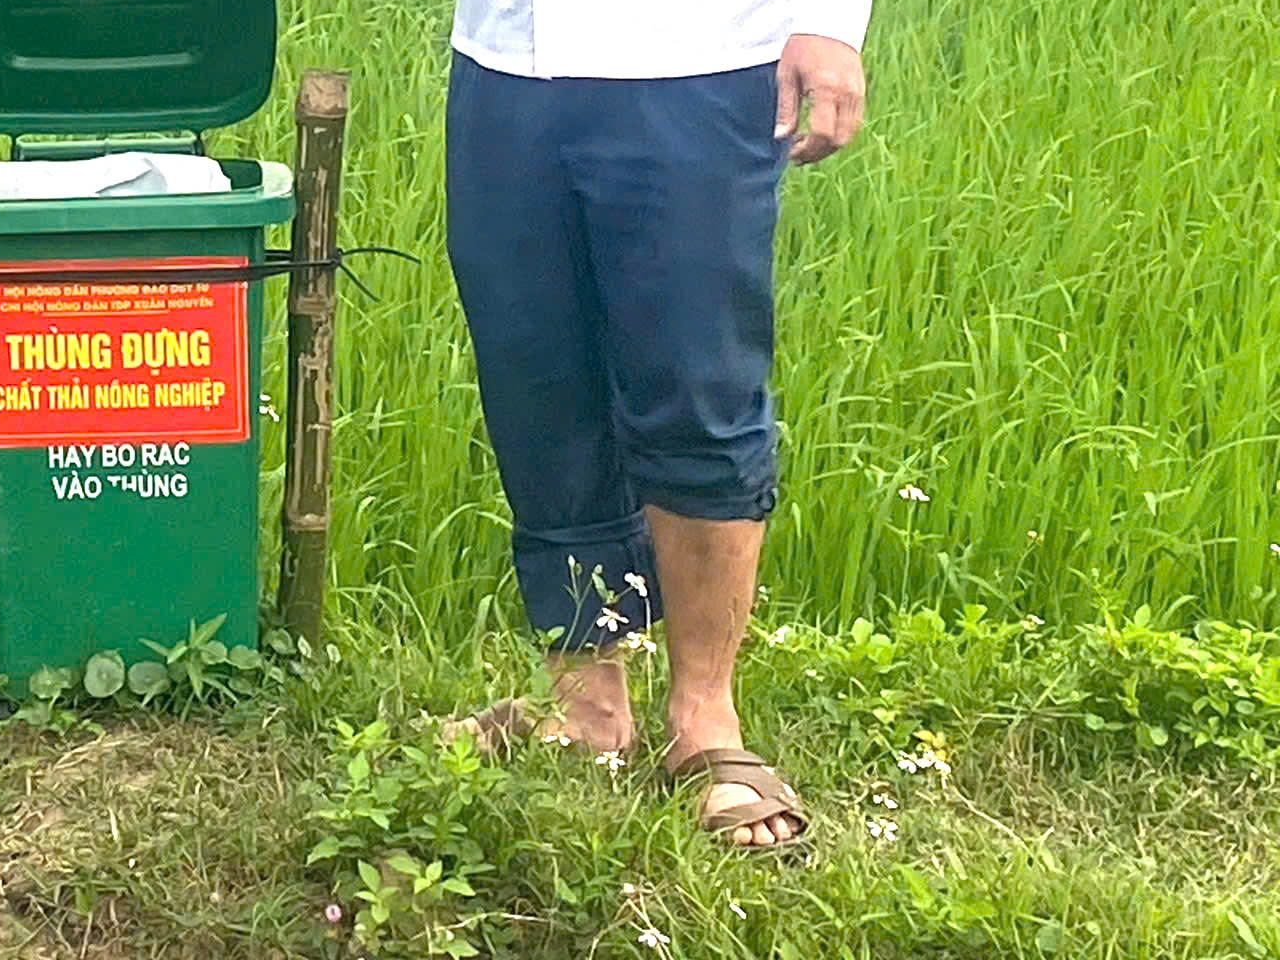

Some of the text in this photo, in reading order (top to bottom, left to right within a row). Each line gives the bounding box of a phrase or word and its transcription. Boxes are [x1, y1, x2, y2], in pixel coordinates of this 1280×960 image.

[5, 325, 211, 376] THÙNG ĐỰNG
[46, 376, 90, 410] THẢI
[95, 378, 150, 409] NÔNG
[155, 376, 226, 412] NGHIỆP
[51, 469, 102, 499] VÀO
